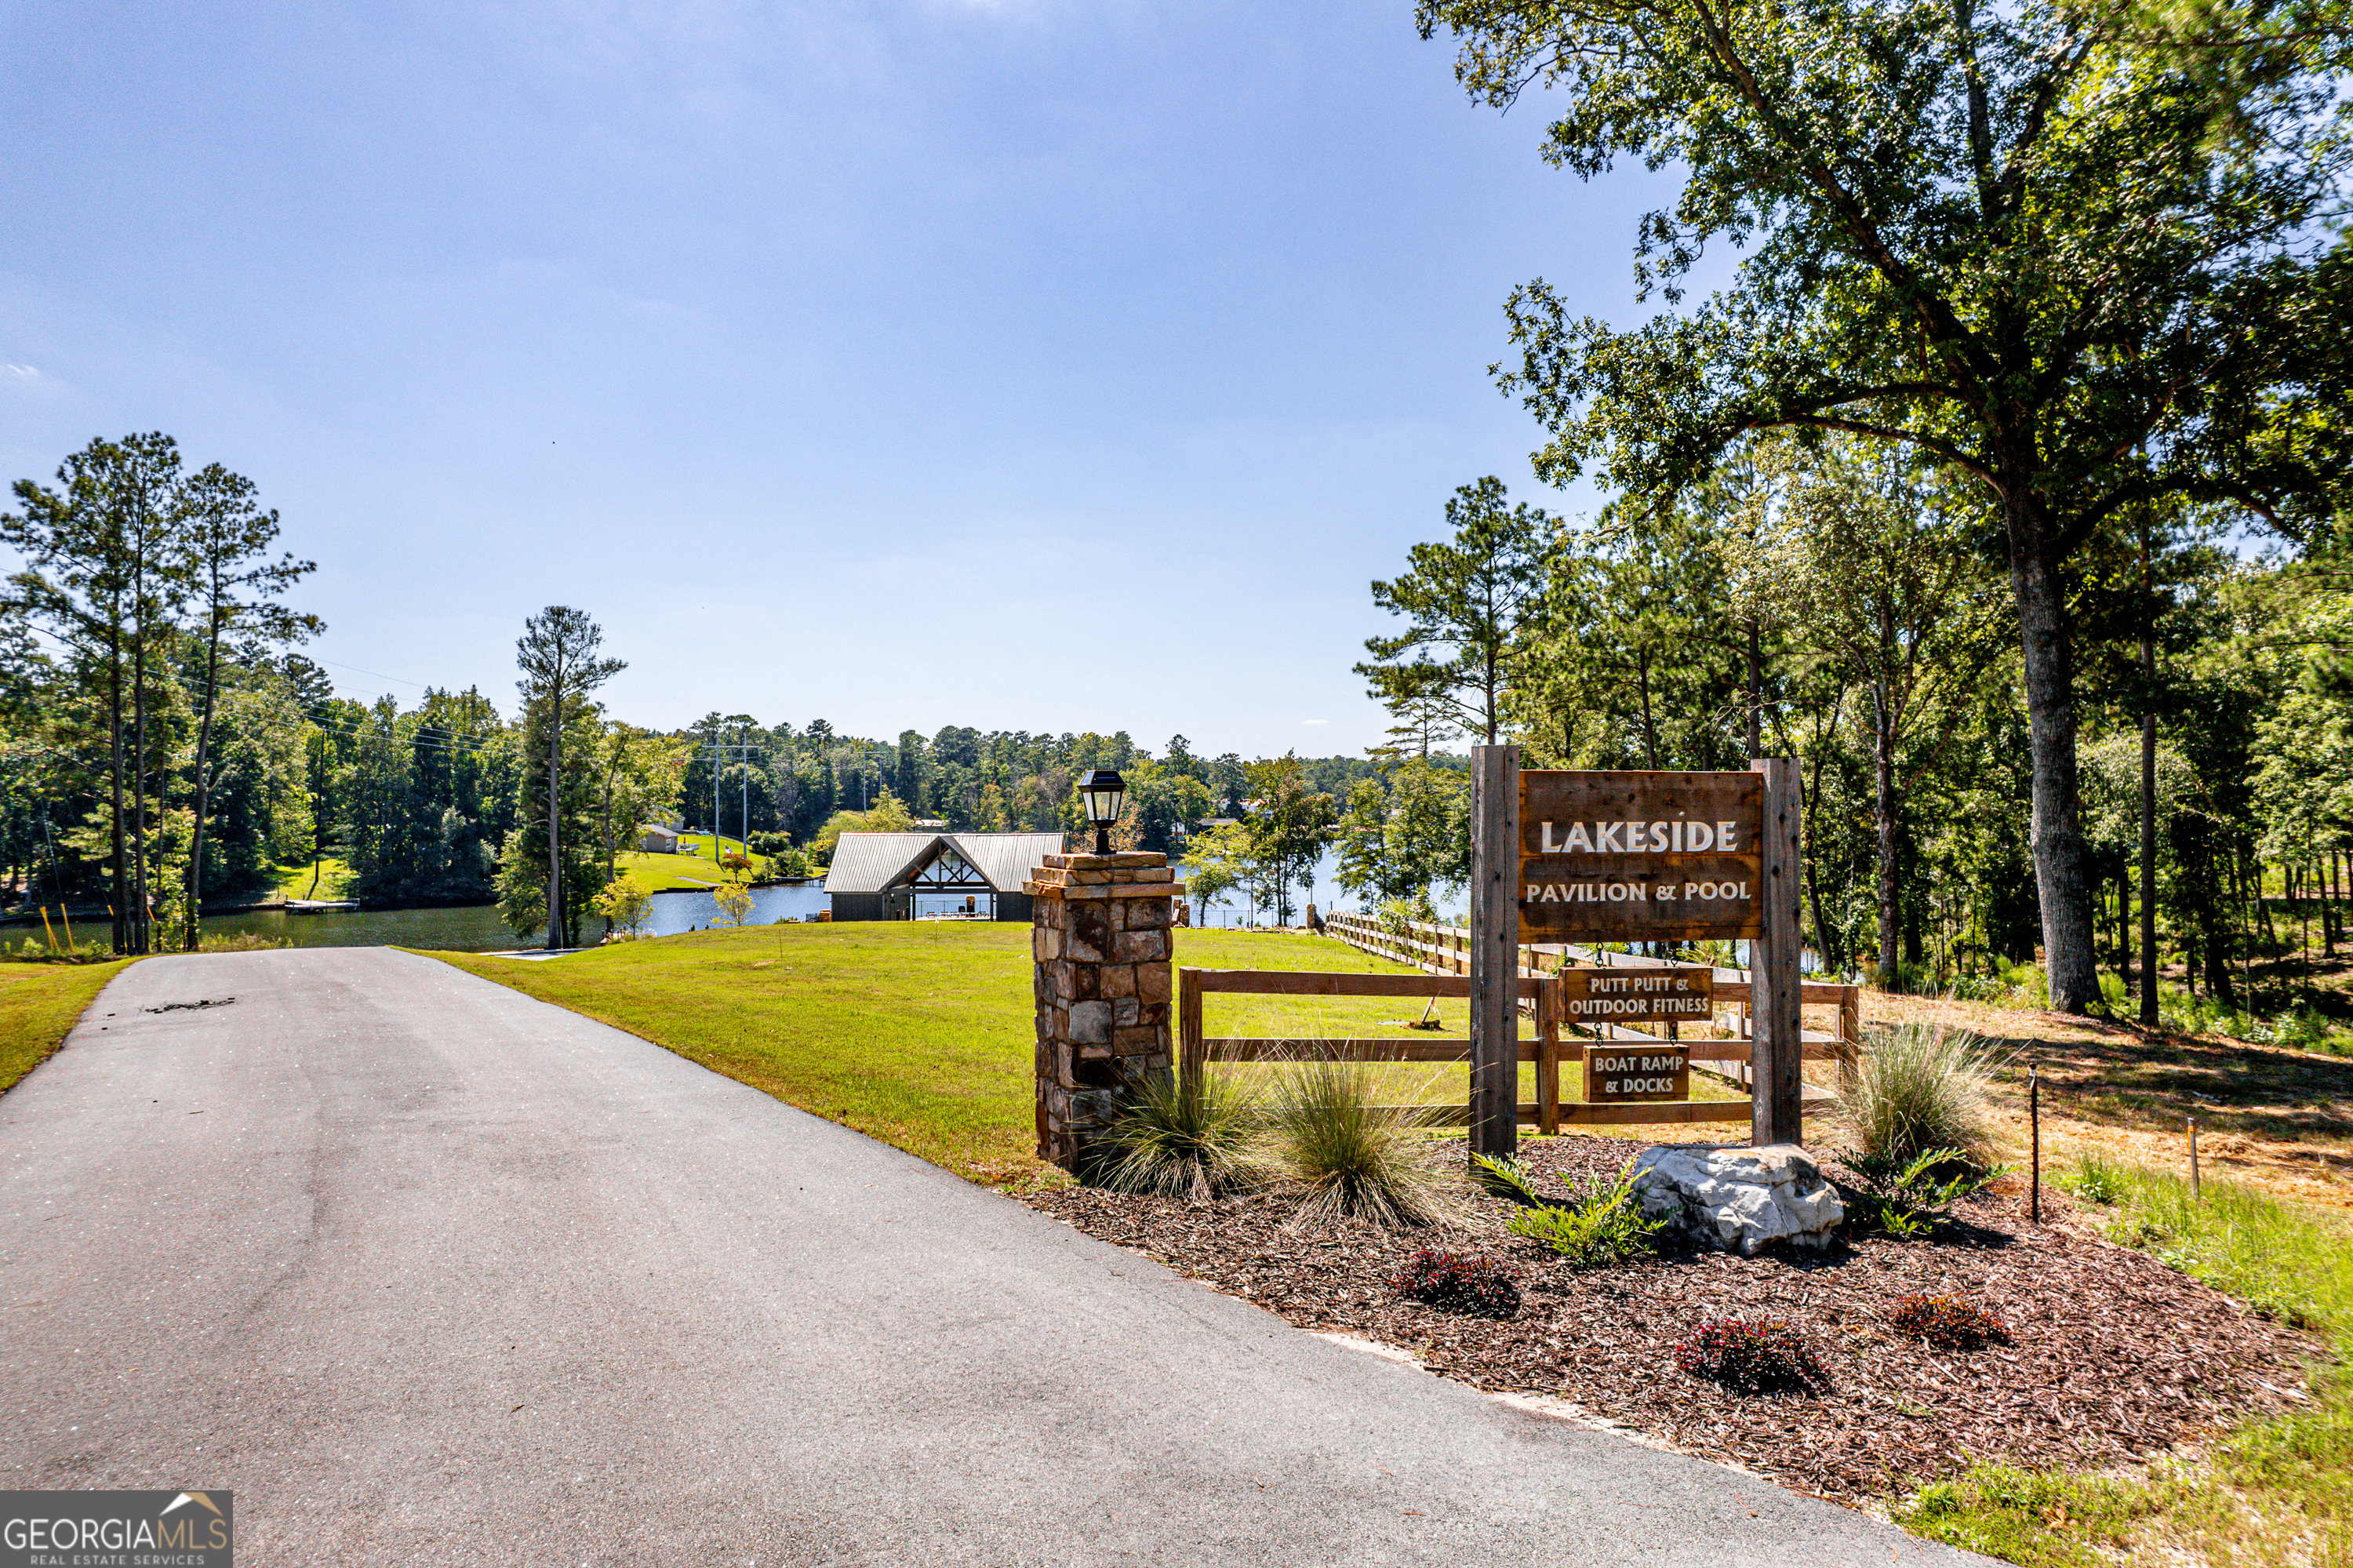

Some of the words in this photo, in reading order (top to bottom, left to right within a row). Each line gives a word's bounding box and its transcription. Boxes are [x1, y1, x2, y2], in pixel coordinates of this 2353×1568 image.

[1541, 821, 1738, 853] LAKESIDE
[1526, 883, 1646, 902] PAVILION
[1656, 886, 1678, 900] &
[1685, 882, 1751, 900] POOL
[1591, 977, 1628, 992] PUTT
[1634, 977, 1671, 991] PUTT
[1676, 979, 1689, 991] &
[1569, 999, 1647, 1014] OUTDOOR
[1653, 998, 1709, 1013] FITNESS
[1595, 1057, 1638, 1072] BOAT
[1642, 1056, 1684, 1071] RAMP
[1605, 1080, 1618, 1093] &
[1624, 1078, 1673, 1093] DOCKS
